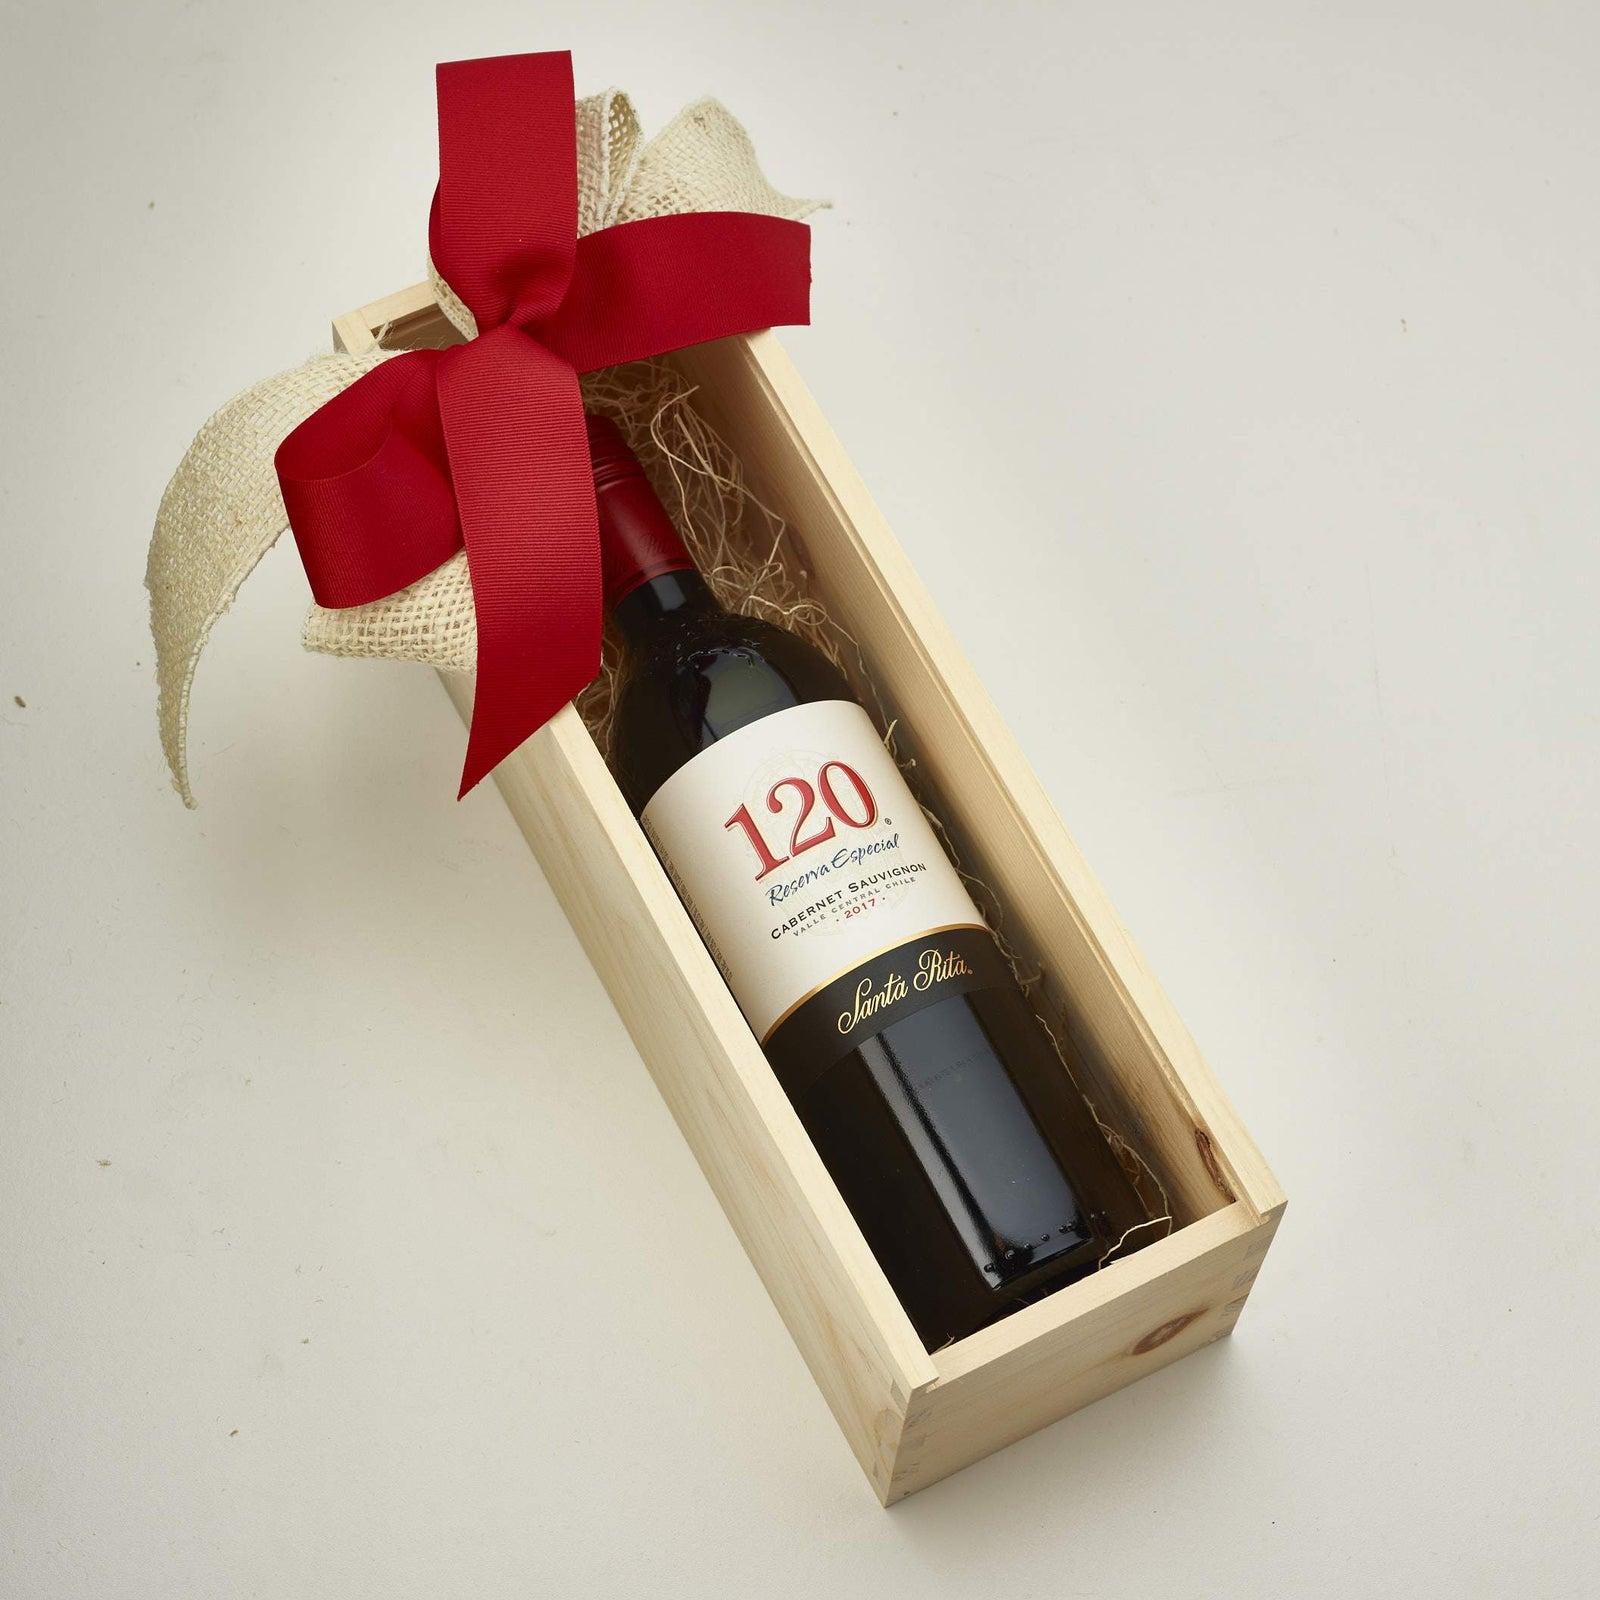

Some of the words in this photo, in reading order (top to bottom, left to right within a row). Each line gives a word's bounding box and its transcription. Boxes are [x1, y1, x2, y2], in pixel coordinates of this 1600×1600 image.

[725, 761, 878, 881] 120
[765, 865, 830, 906] Reserva
[831, 833, 899, 869] Especial
[771, 891, 842, 939] CABERNET
[848, 863, 927, 893] SAUVIGNON
[793, 914, 826, 937] VALLE
[831, 888, 881, 914] CENTRAL
[885, 876, 917, 889] CHILE
[844, 898, 876, 919] 2017
[837, 973, 909, 1034] Santa
[913, 949, 967, 991] Rita
